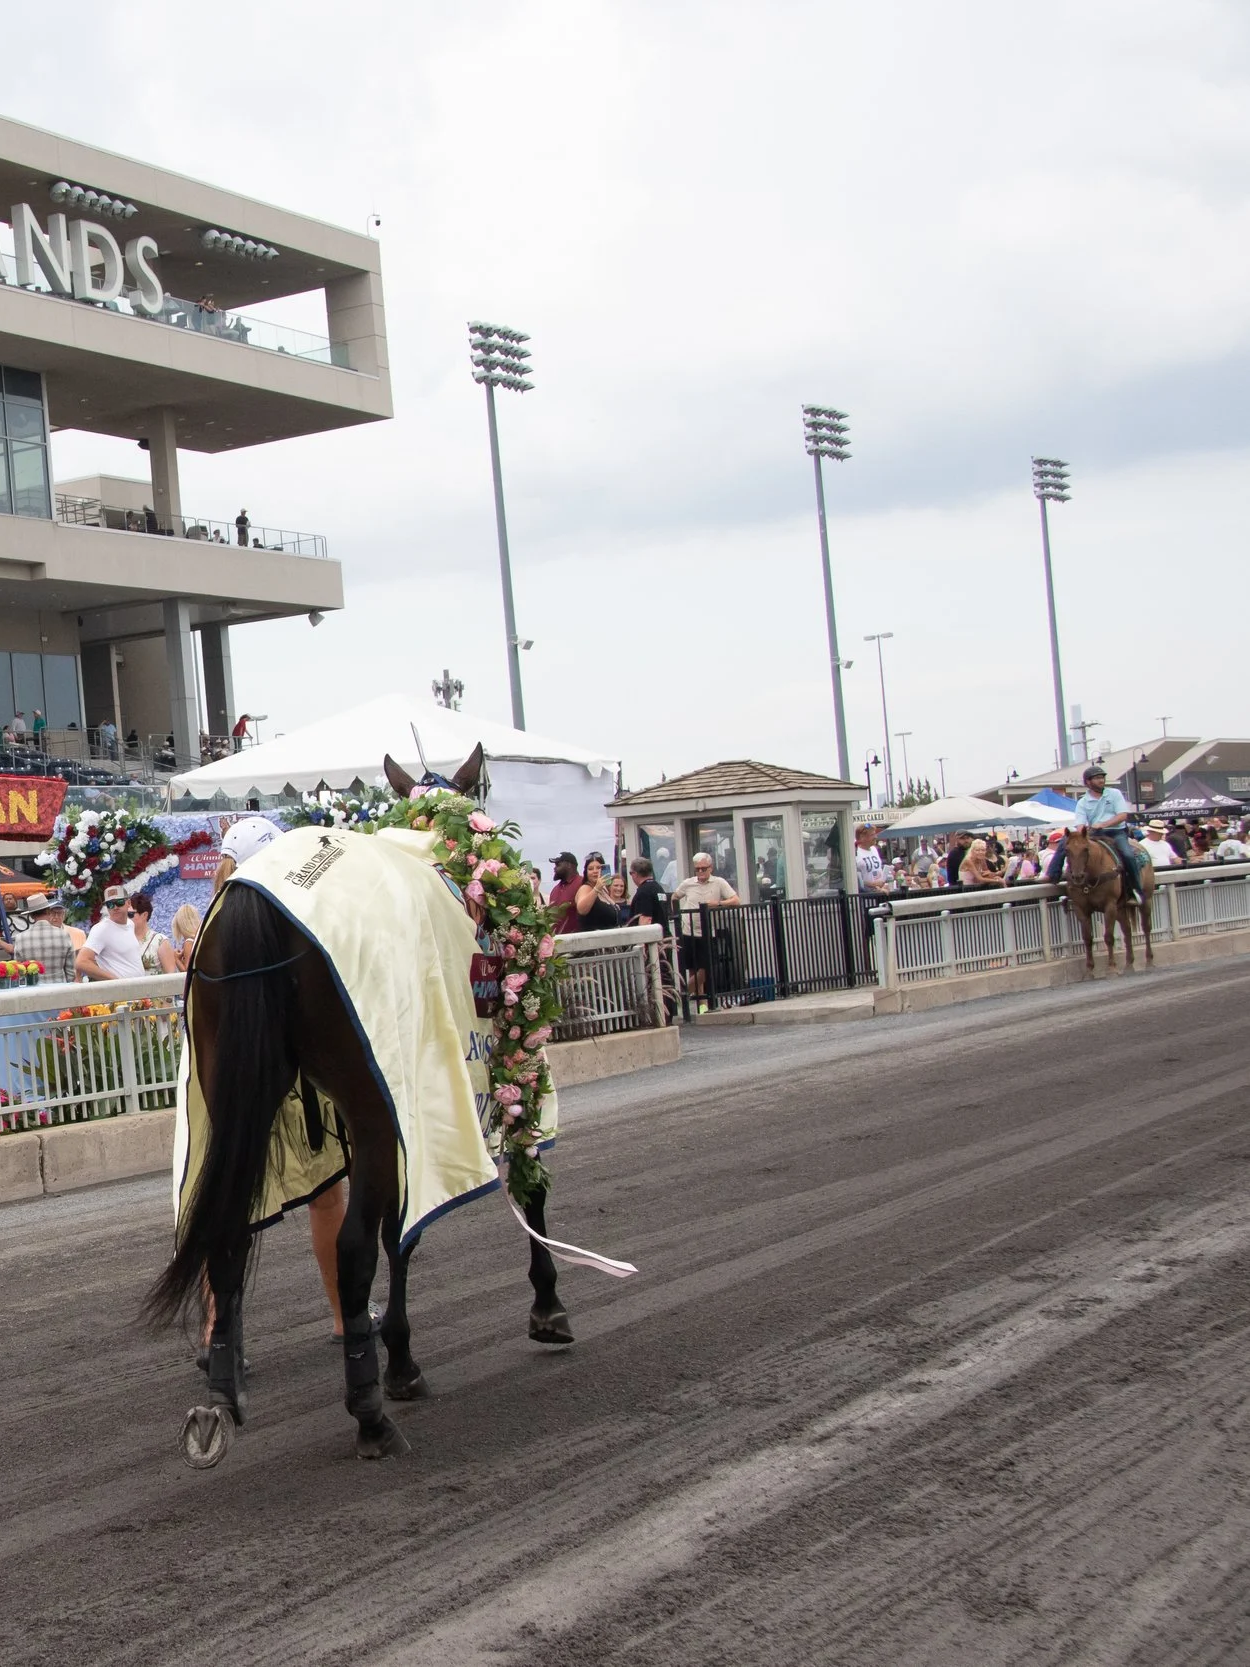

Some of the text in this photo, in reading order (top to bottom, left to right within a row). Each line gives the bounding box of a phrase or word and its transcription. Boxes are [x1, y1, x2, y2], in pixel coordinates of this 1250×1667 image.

[866, 813, 885, 822] CAKES
[1143, 809, 1209, 819] Tornado Potato
[291, 844, 336, 885] GRAND CIRCUIT
